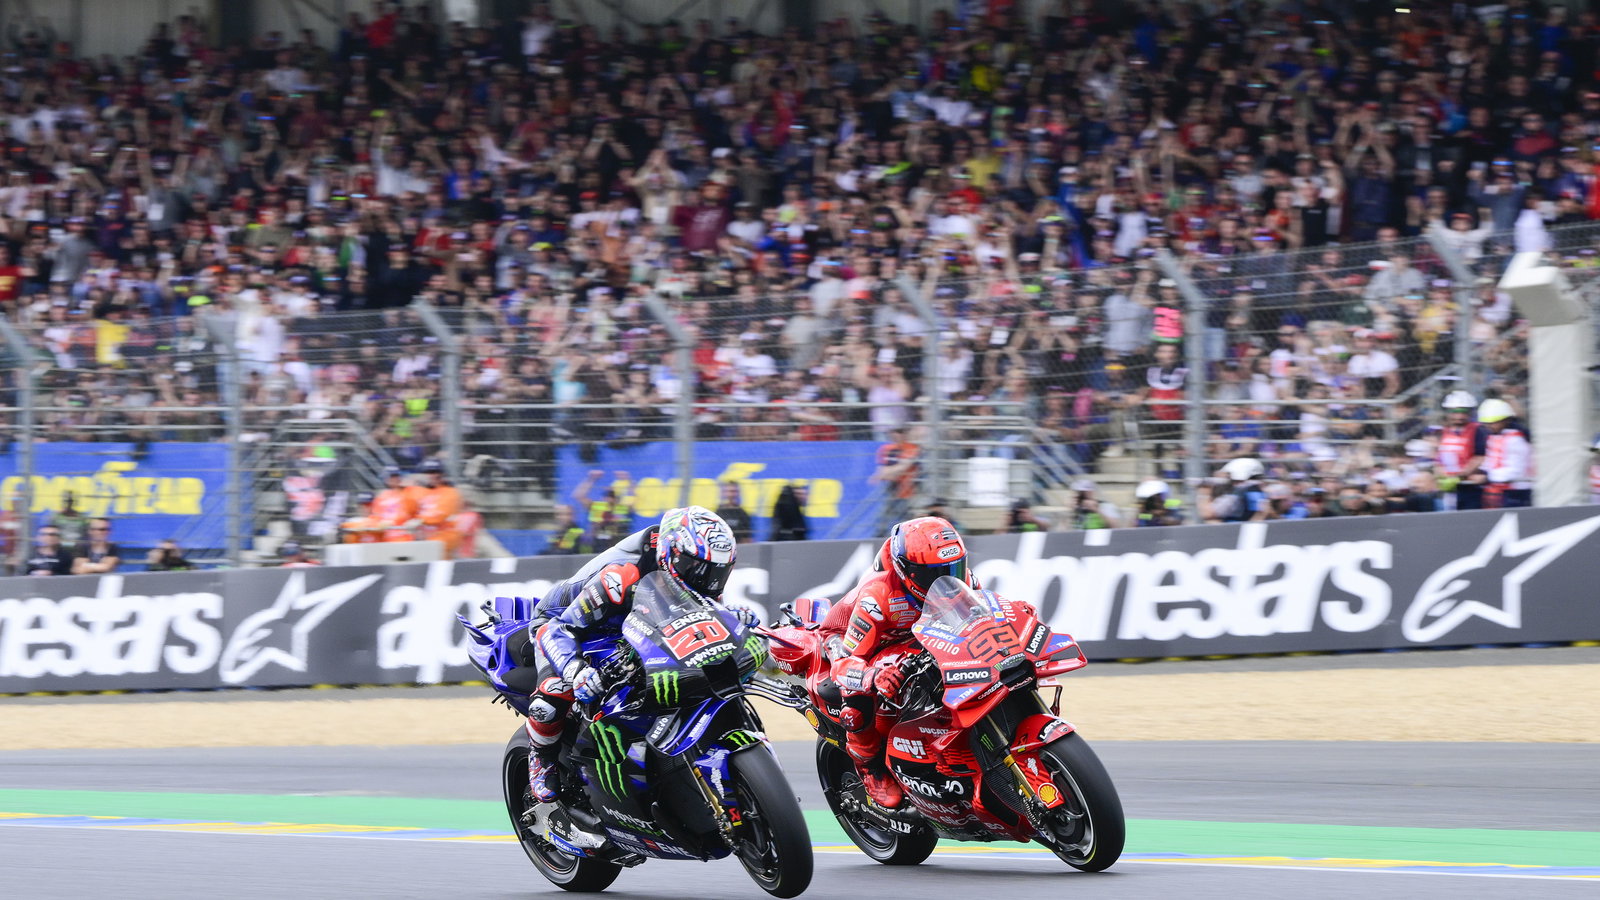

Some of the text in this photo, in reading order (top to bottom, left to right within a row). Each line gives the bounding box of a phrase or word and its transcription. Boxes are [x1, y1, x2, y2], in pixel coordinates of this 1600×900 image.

[672, 610, 713, 630] ENEOS
[541, 629, 566, 668] YAMAHA
[662, 617, 731, 660] 20
[967, 622, 1021, 663] 93
[1026, 625, 1046, 654] Lenovo
[684, 642, 737, 668] MONSTER
[946, 671, 989, 682] Lenovo
[959, 688, 975, 700] TIM
[892, 736, 926, 756] GIVI
